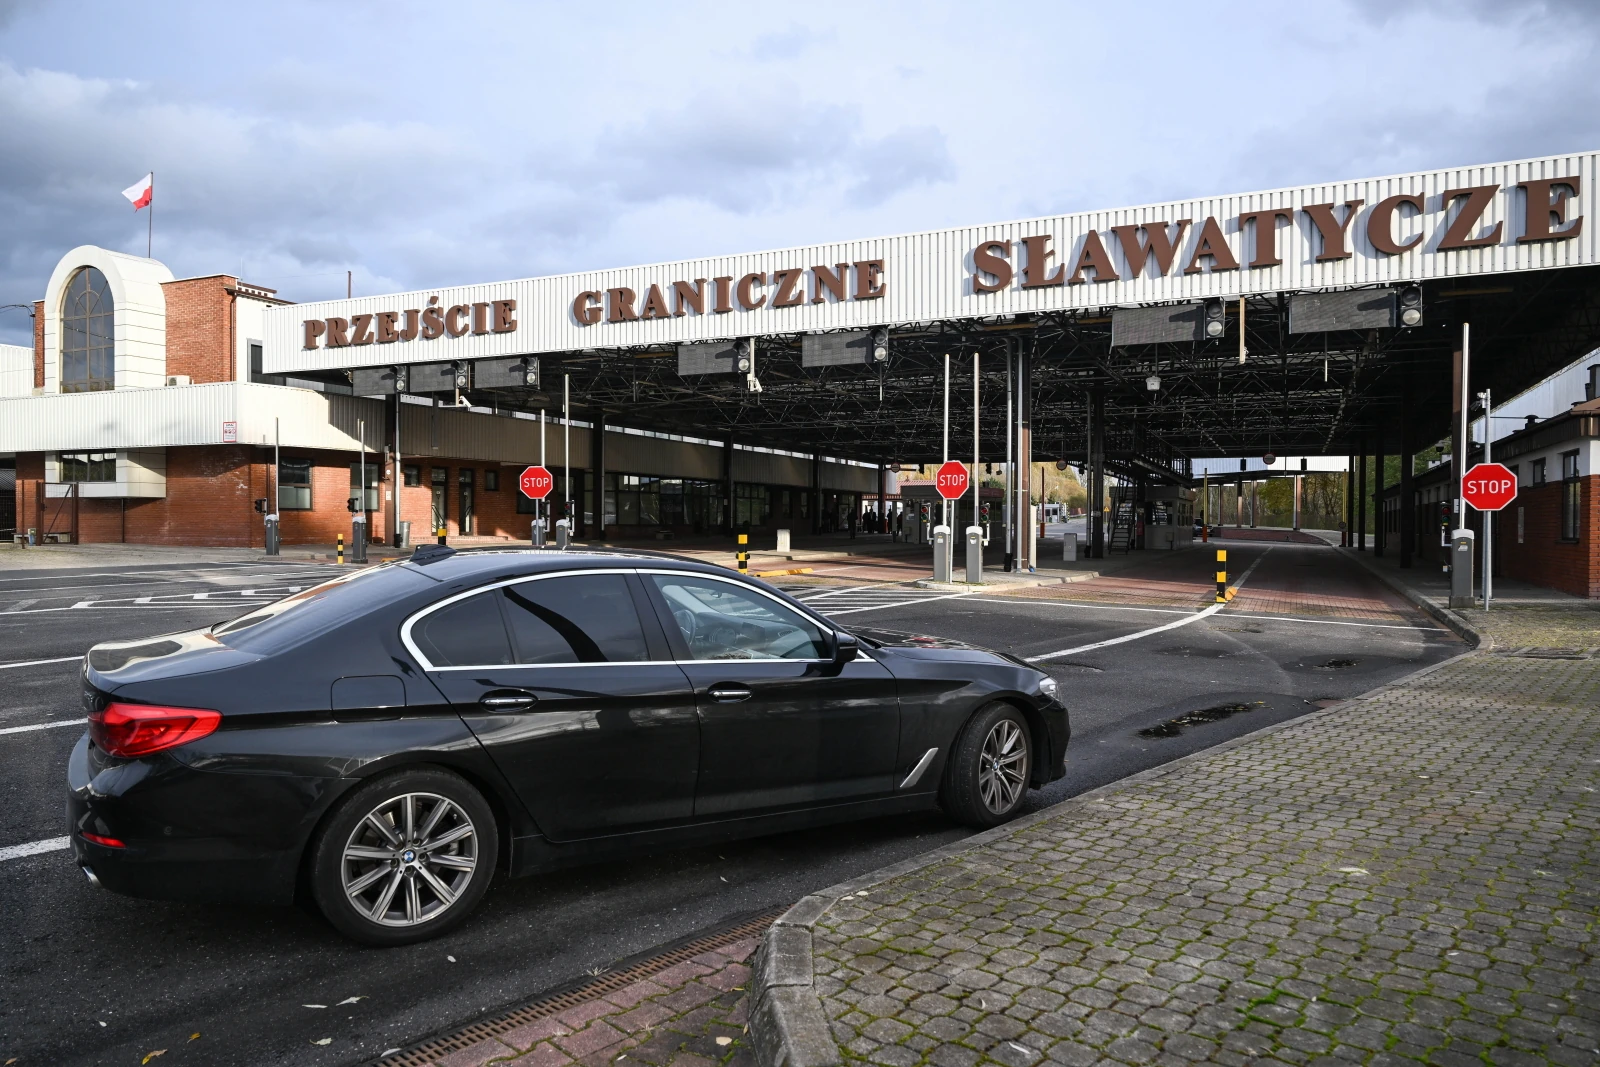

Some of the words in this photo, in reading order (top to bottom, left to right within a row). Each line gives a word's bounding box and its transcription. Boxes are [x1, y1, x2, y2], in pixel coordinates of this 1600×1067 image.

[303, 296, 517, 349] PRZEJŚCIE
[573, 259, 887, 325] GRANICZNE
[972, 176, 1584, 293] SŁAWATYCZE
[523, 477, 550, 488] STOP
[940, 474, 966, 486] STOP
[1467, 480, 1511, 494] STOP
